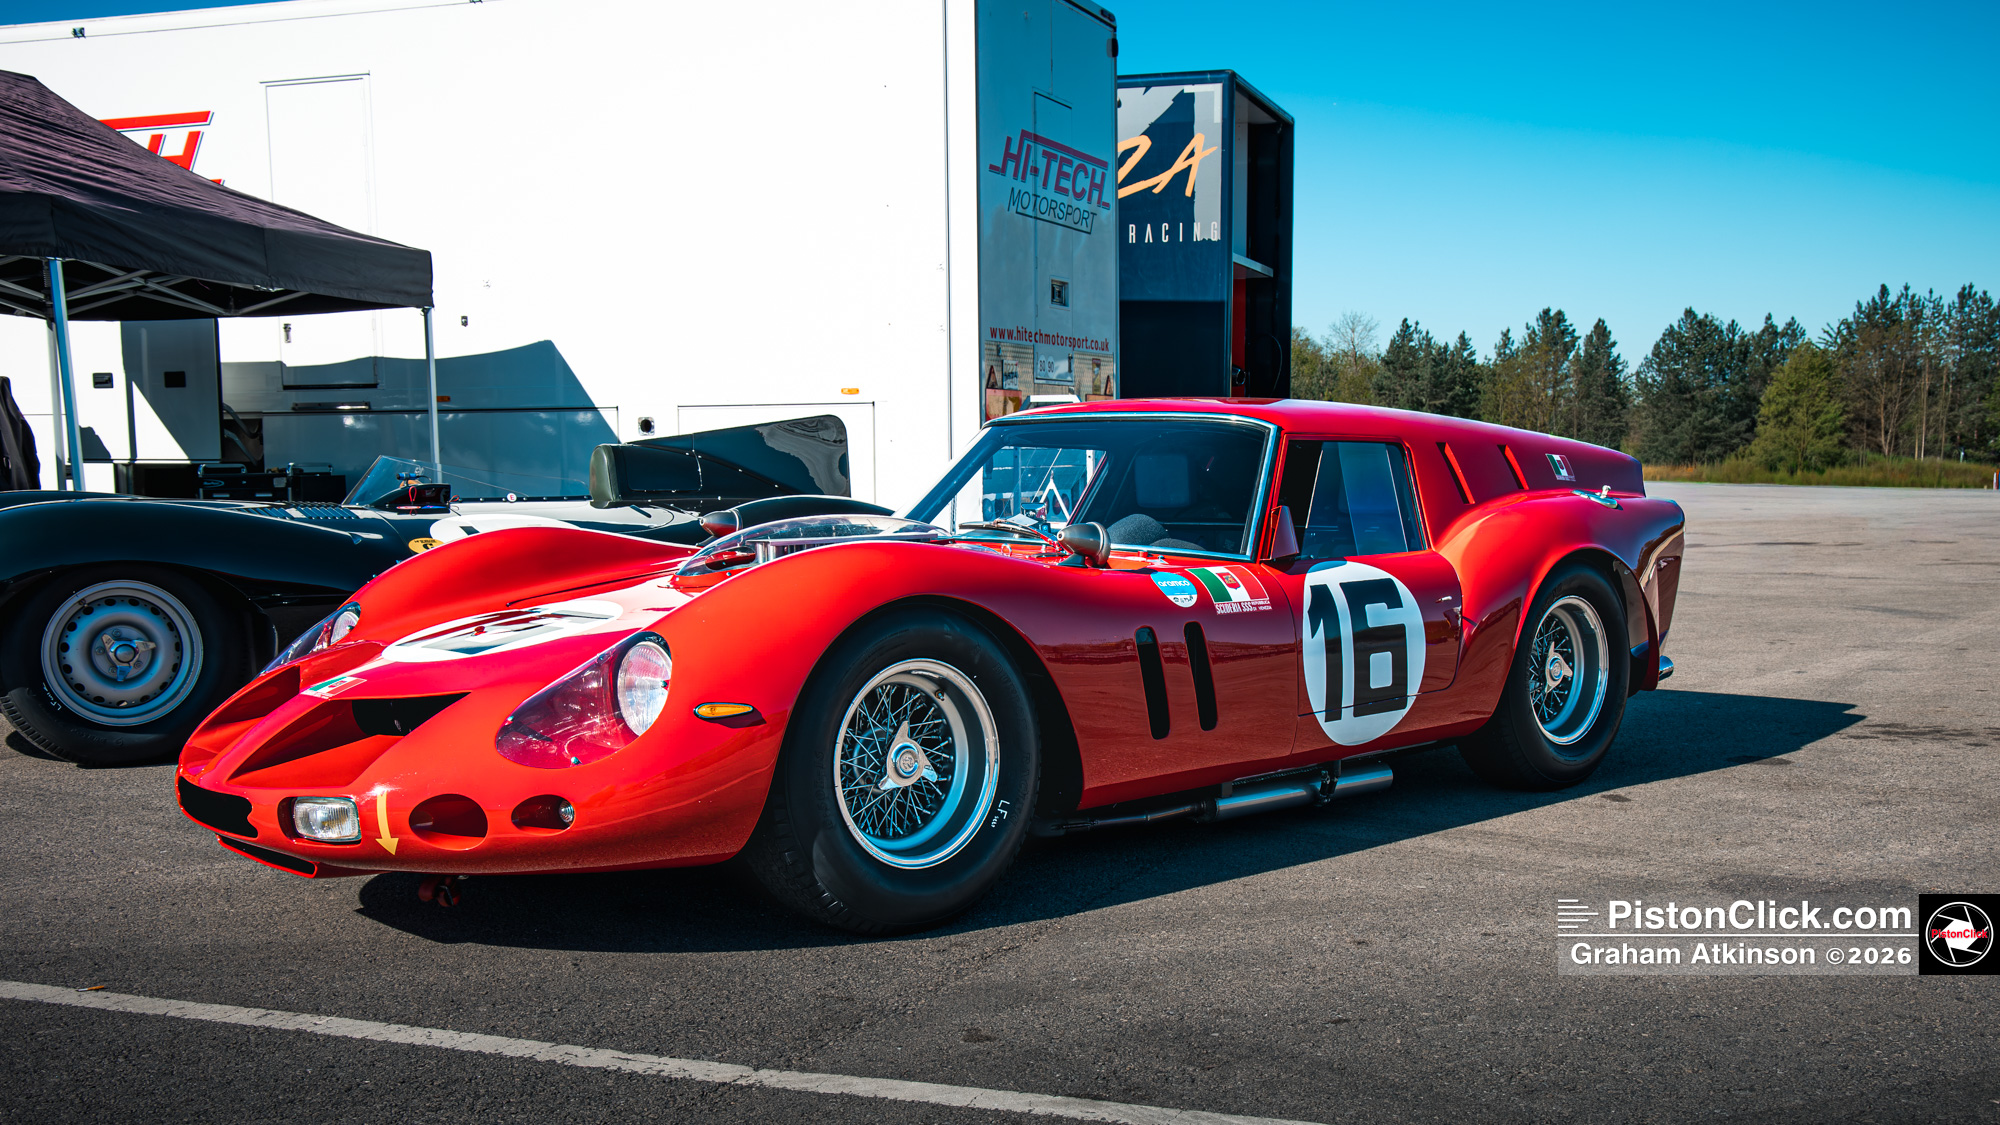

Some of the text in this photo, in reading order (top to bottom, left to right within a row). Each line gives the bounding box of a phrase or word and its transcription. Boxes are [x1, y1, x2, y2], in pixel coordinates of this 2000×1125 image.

[989, 129, 1110, 209] HI-TECH
[1007, 187, 1097, 234] MOTORSPORT
[1128, 222, 1218, 243] RACING
[990, 326, 1109, 352] www.hitechmotorsport.co.uk
[1241, 601, 1253, 612] SSS
[1308, 578, 1408, 722] 16
[997, 799, 1010, 820] LF
